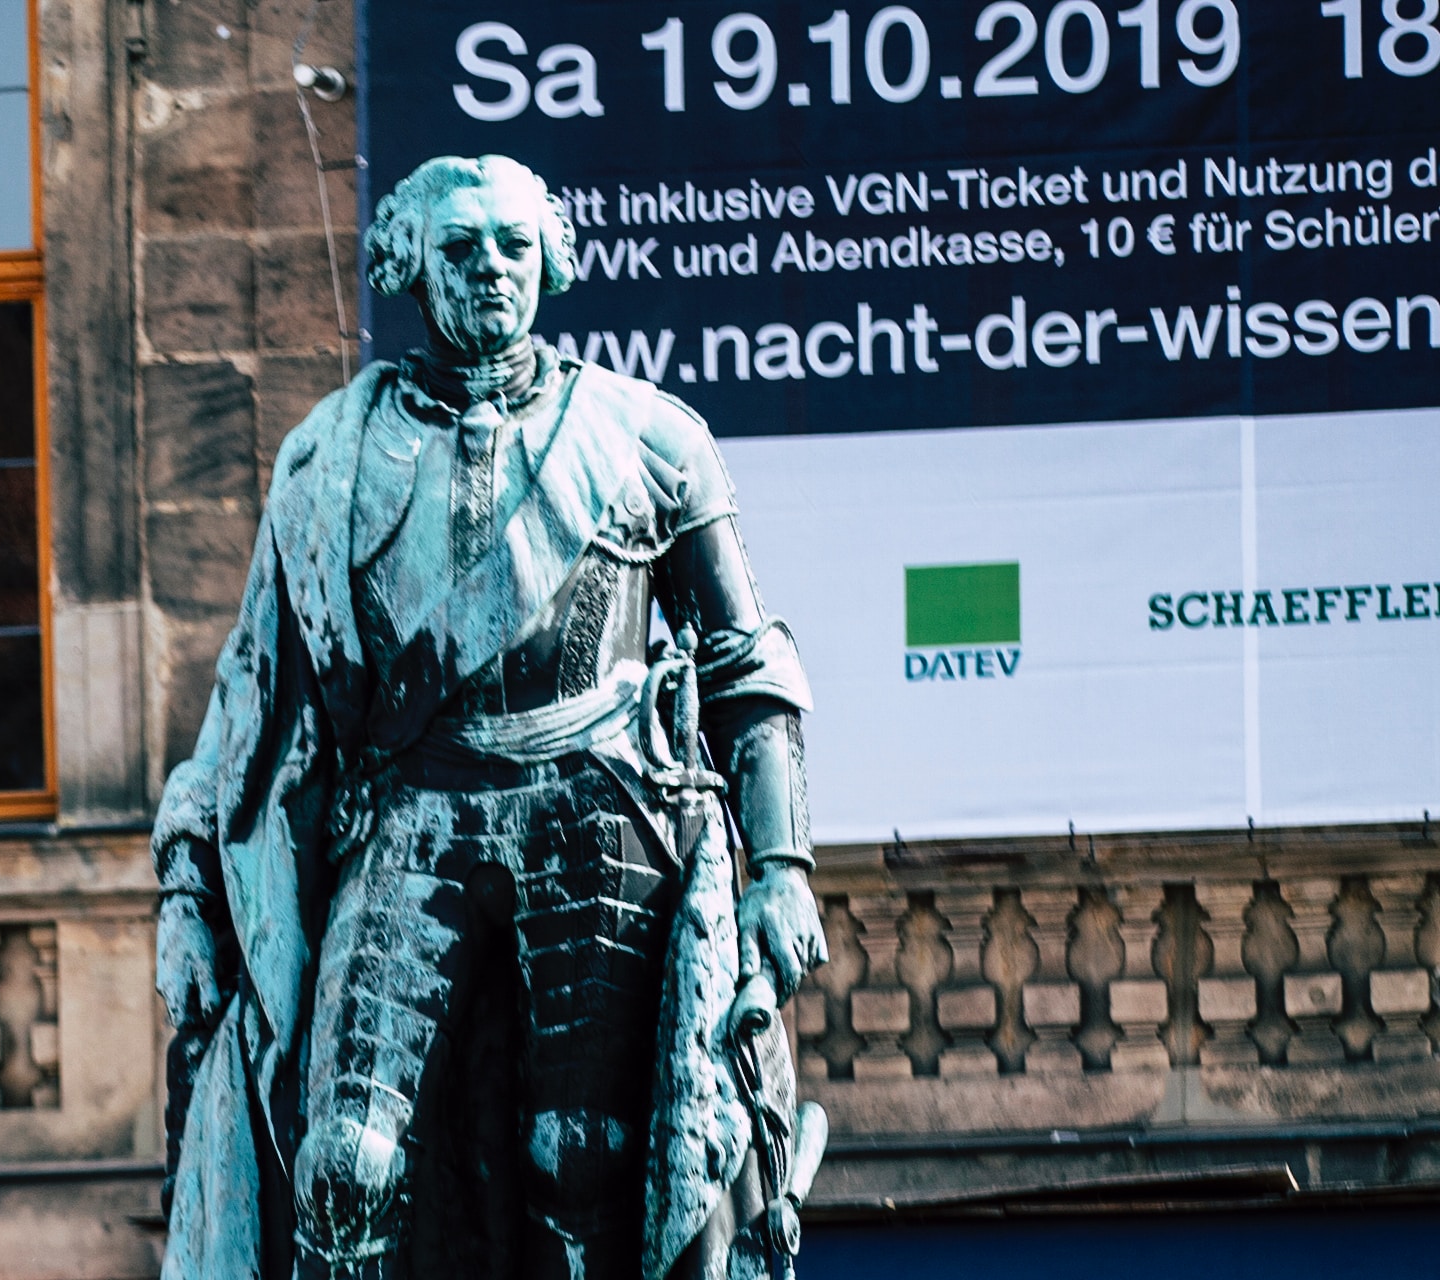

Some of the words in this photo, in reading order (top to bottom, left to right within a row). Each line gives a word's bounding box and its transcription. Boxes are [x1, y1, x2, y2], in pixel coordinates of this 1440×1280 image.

[452, 24, 605, 121] Sa
[641, 0, 1240, 112] 19.10.2019
[618, 178, 815, 226] inklusive
[825, 165, 1089, 216] VGN-Ticket
[1103, 159, 1188, 202] und
[1204, 156, 1393, 199] Nutzung
[1409, 147, 1440, 188] d
[673, 233, 758, 279] und
[771, 225, 1065, 273] Abendkasse,
[1080, 217, 1135, 258] 10
[1146, 214, 1176, 254] €
[1189, 212, 1252, 253] für
[1265, 205, 1440, 250] Schüler
[1148, 583, 1440, 630] SCHAEFFLE
[904, 648, 1021, 682] DATEV
